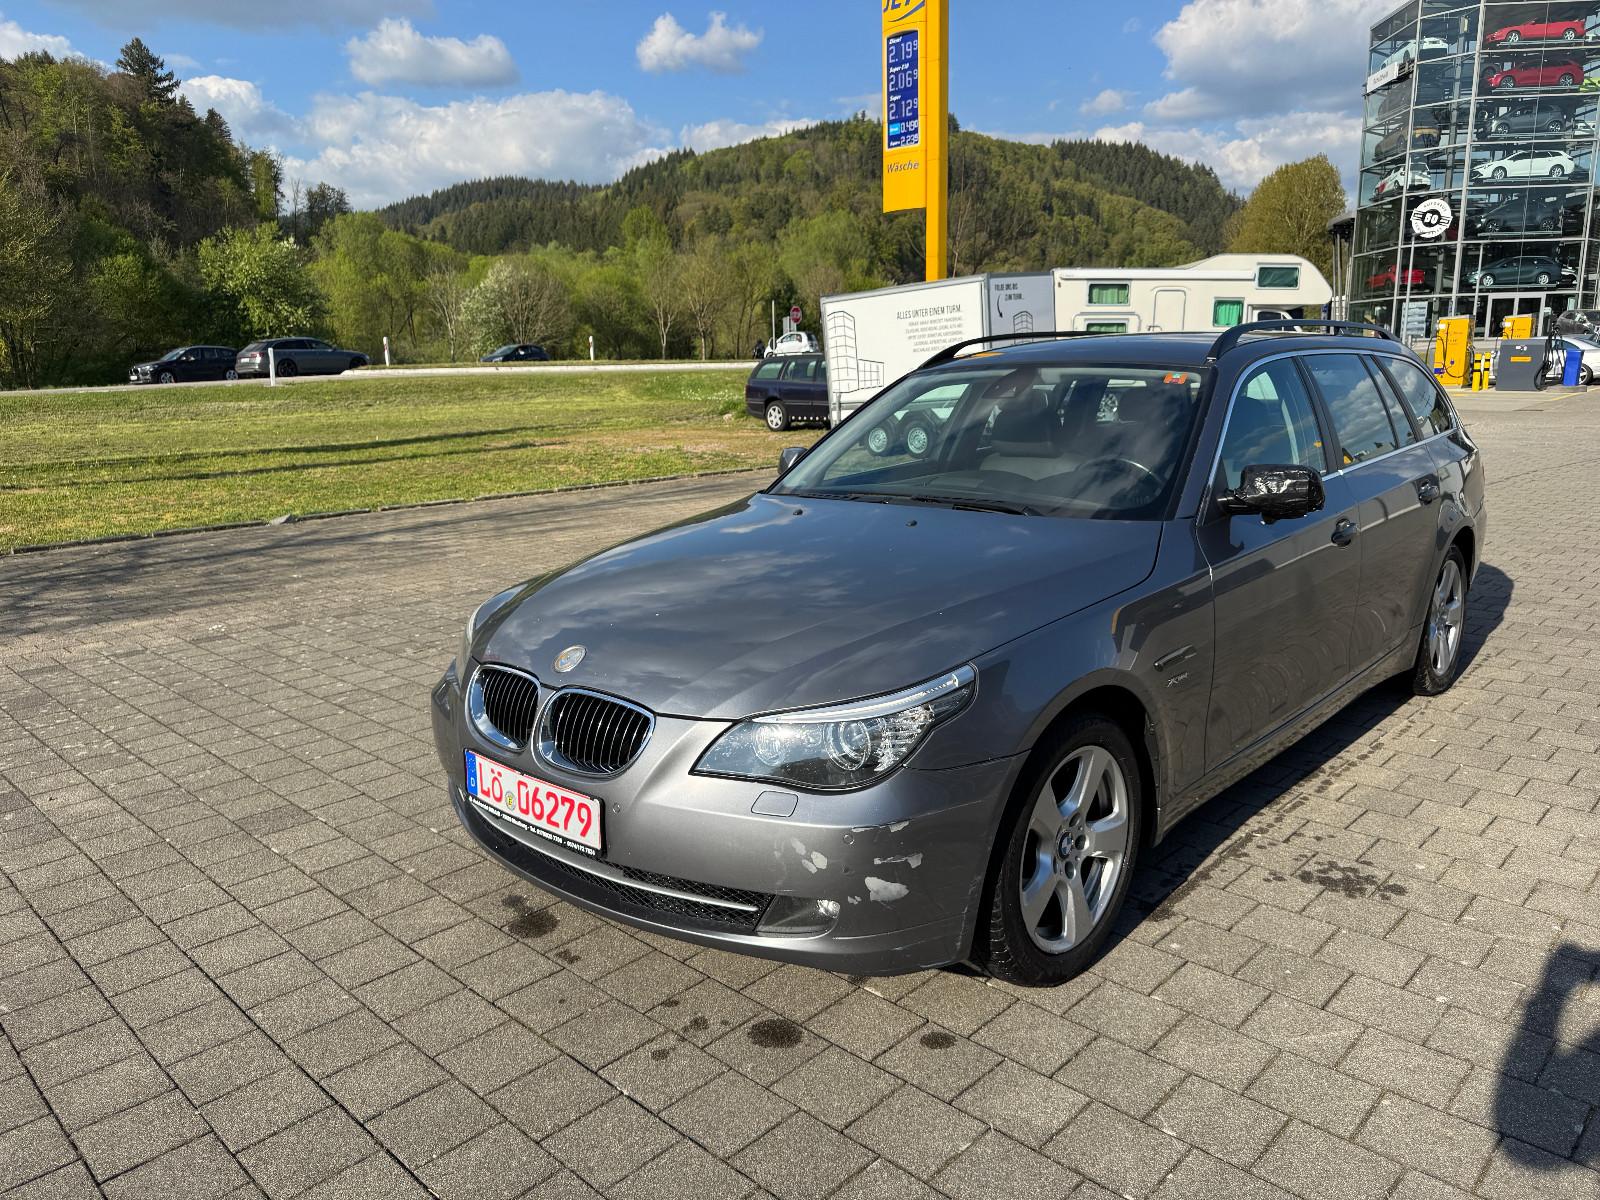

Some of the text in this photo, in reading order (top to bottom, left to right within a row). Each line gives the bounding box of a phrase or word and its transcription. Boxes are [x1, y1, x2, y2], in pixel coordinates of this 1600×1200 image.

[887, 160, 919, 173] Wäsche
[896, 310, 911, 320] ALLES
[912, 308, 929, 318] UNTER
[929, 306, 945, 316] EINEM
[470, 777, 476, 787] D
[478, 762, 503, 803] LÖ
[517, 780, 592, 837] 06279
